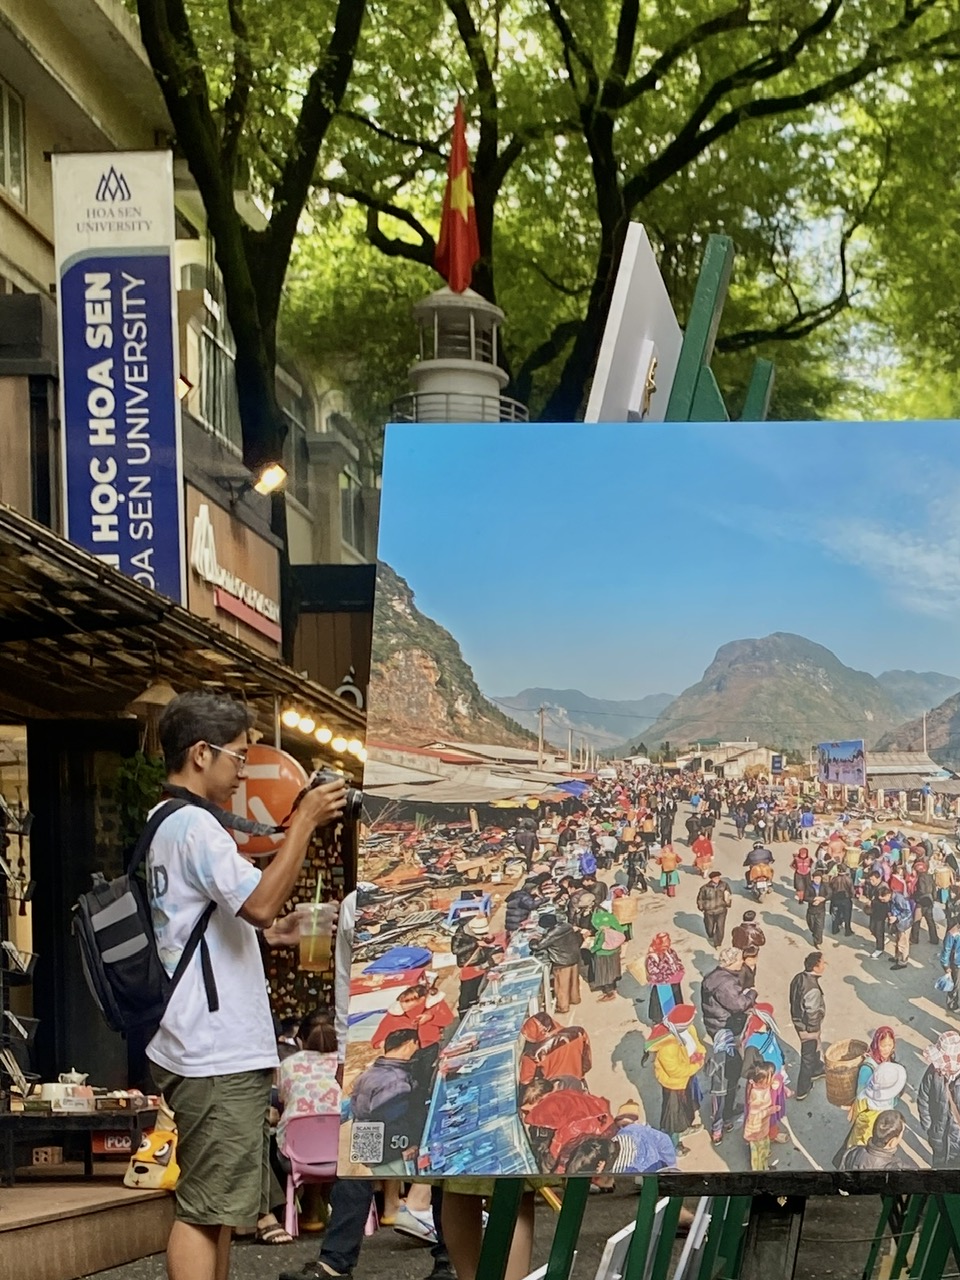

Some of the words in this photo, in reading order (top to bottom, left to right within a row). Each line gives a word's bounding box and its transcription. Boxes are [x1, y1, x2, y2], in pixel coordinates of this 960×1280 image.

[76, 220, 152, 232] UNIVERSITY
[86, 207, 115, 219] HOA
[117, 206, 142, 218] SEN
[84, 272, 113, 349] SEN
[121, 271, 151, 466] UNIVERSITY
[87, 358, 116, 446] HOA
[89, 456, 126, 542] HỌC
[127, 476, 154, 541] SEN
[130, 547, 156, 591] OA
[390, 1135, 409, 1149] 50
